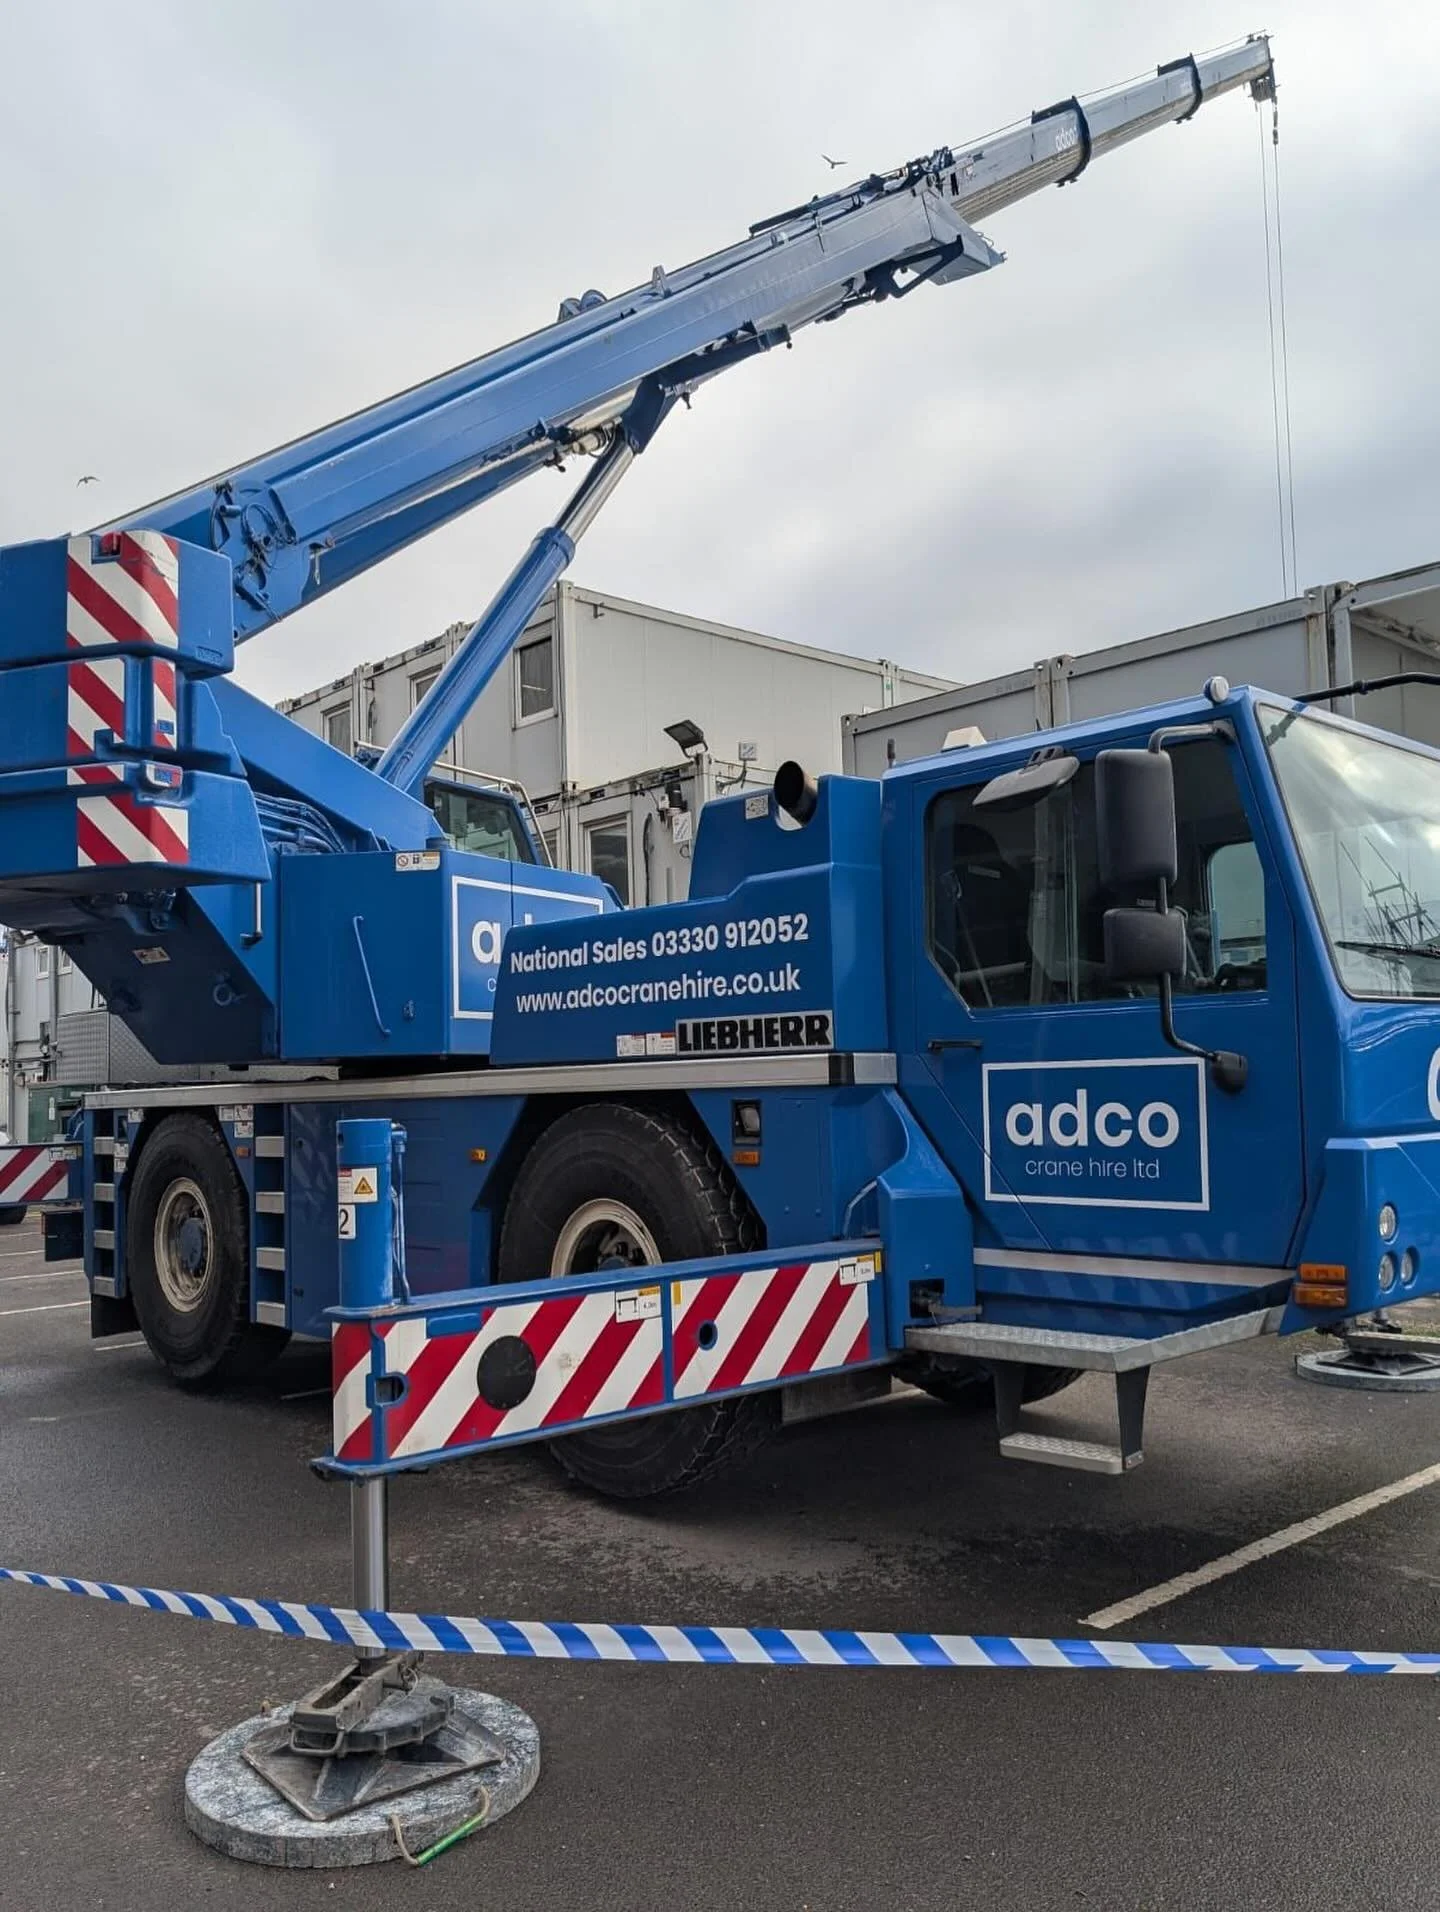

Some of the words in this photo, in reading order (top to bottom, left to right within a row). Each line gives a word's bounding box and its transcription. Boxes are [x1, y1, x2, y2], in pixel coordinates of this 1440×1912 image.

[511, 942, 588, 974] National
[593, 937, 647, 964] Sales
[652, 925, 719, 957] 03330
[725, 913, 809, 949] 912052
[516, 963, 801, 1013] www.adcocranehire.co.uk
[678, 1015, 831, 1052] LIEBHERR
[1005, 1088, 1180, 1148] adco
[1025, 1159, 1083, 1177] crane
[1089, 1158, 1127, 1177] hire
[1133, 1158, 1160, 1178] ltd
[339, 1208, 349, 1235] 2
